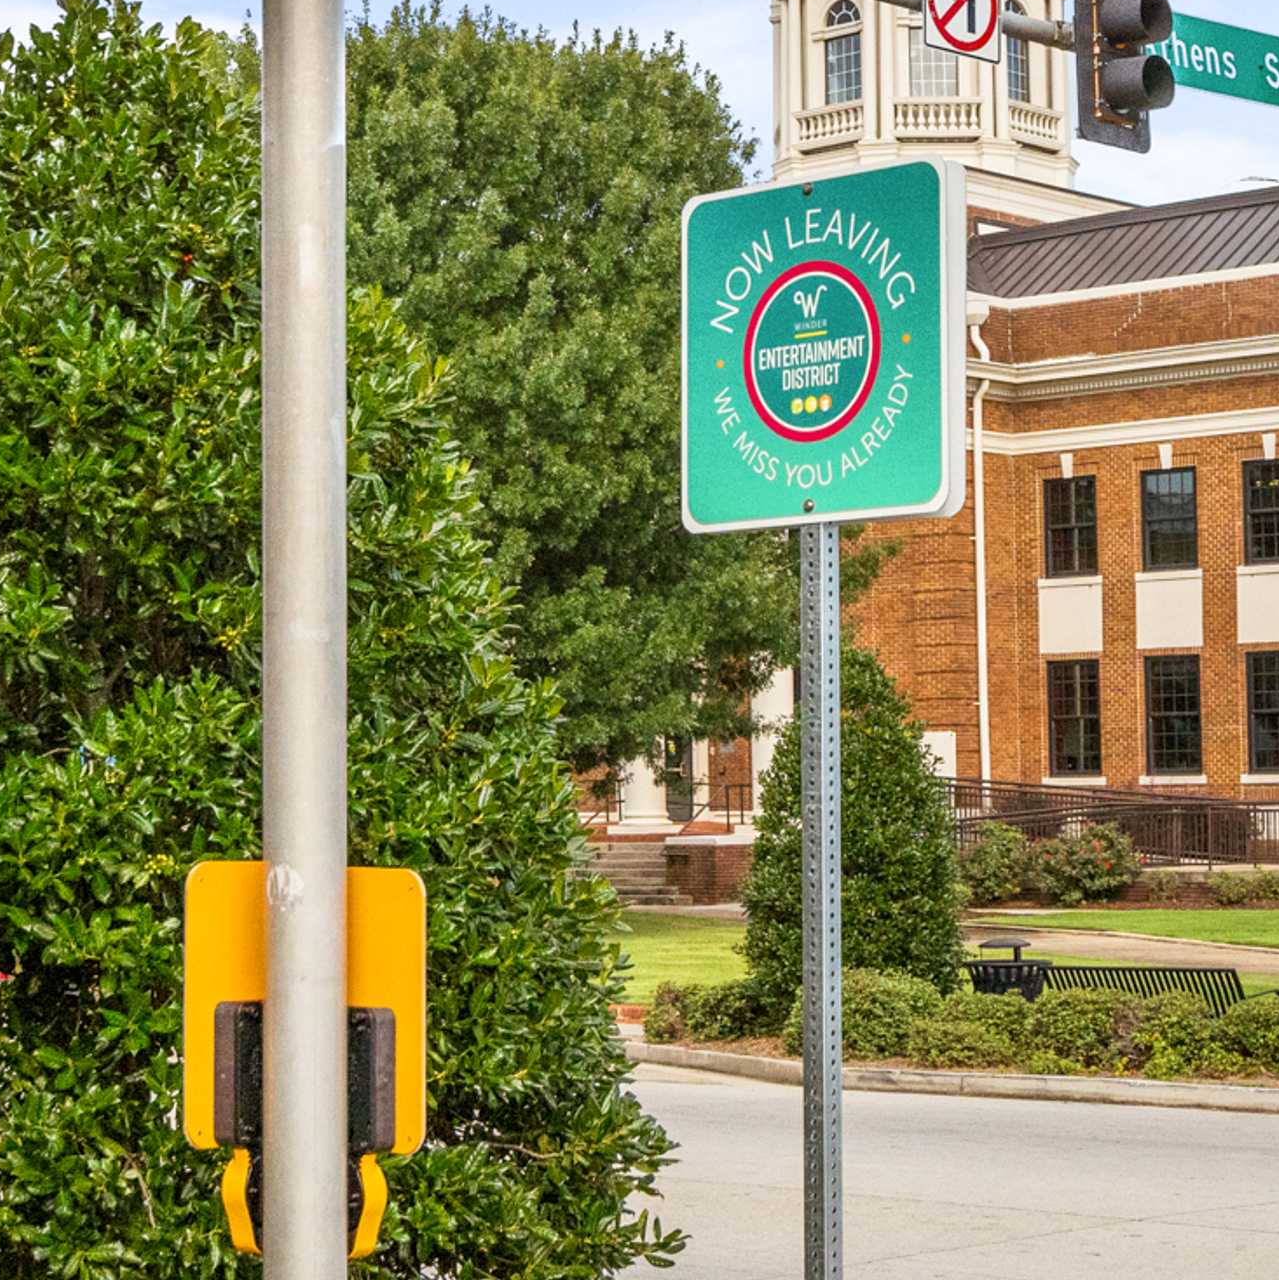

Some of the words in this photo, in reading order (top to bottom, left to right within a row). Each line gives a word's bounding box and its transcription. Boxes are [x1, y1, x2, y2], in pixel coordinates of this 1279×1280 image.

[710, 229, 774, 334] NOW
[784, 207, 916, 310] LEAVING
[758, 334, 865, 371] ENTERTAINMENT
[782, 362, 840, 391] DISTRICT
[713, 386, 740, 435] WE
[732, 430, 780, 481] MISS
[784, 460, 833, 489] YOU
[840, 364, 913, 479] ALREADY
